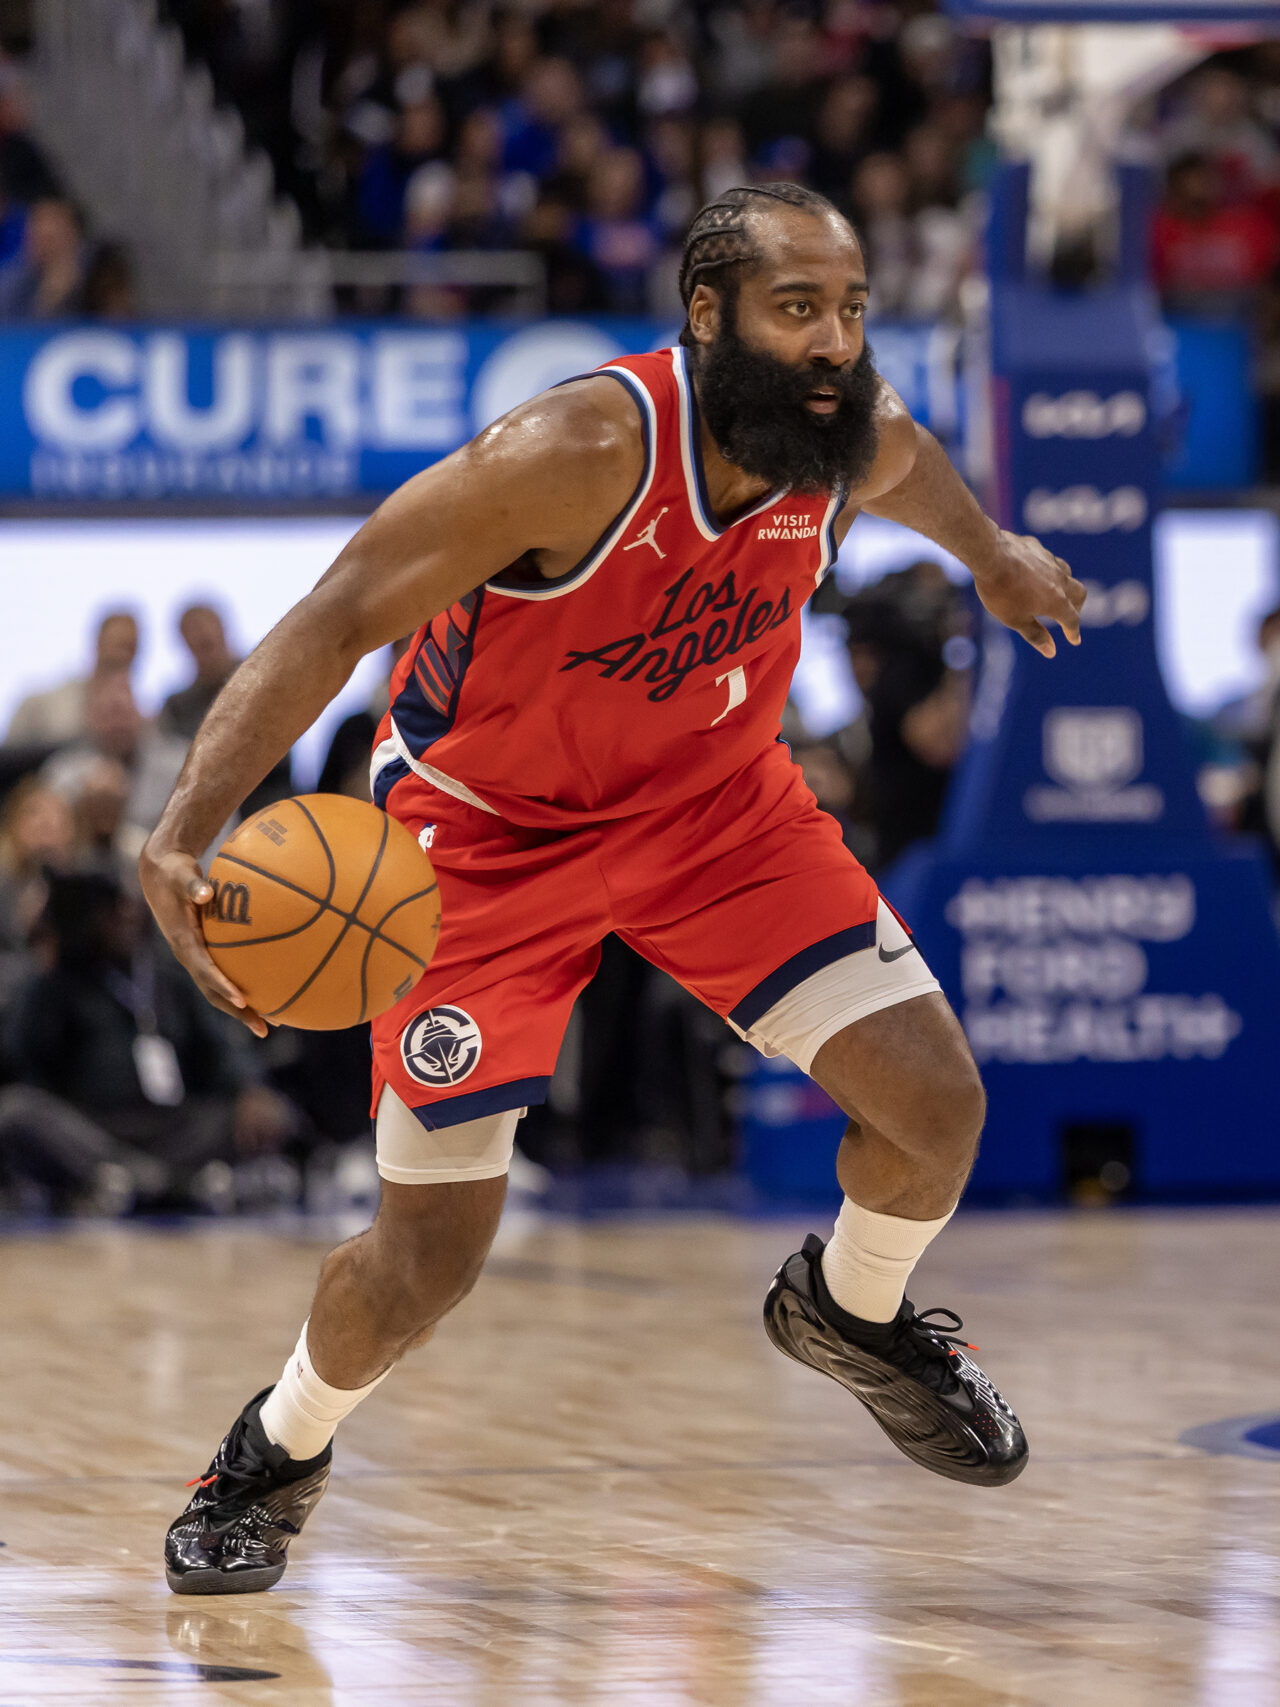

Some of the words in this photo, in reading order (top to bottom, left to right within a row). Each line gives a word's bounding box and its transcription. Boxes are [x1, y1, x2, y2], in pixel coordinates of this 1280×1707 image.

[24, 330, 469, 452] CURE
[757, 525, 818, 540] RWANDA
[773, 514, 811, 527] VISIT
[649, 566, 742, 641] Los
[558, 586, 794, 703] Angeles
